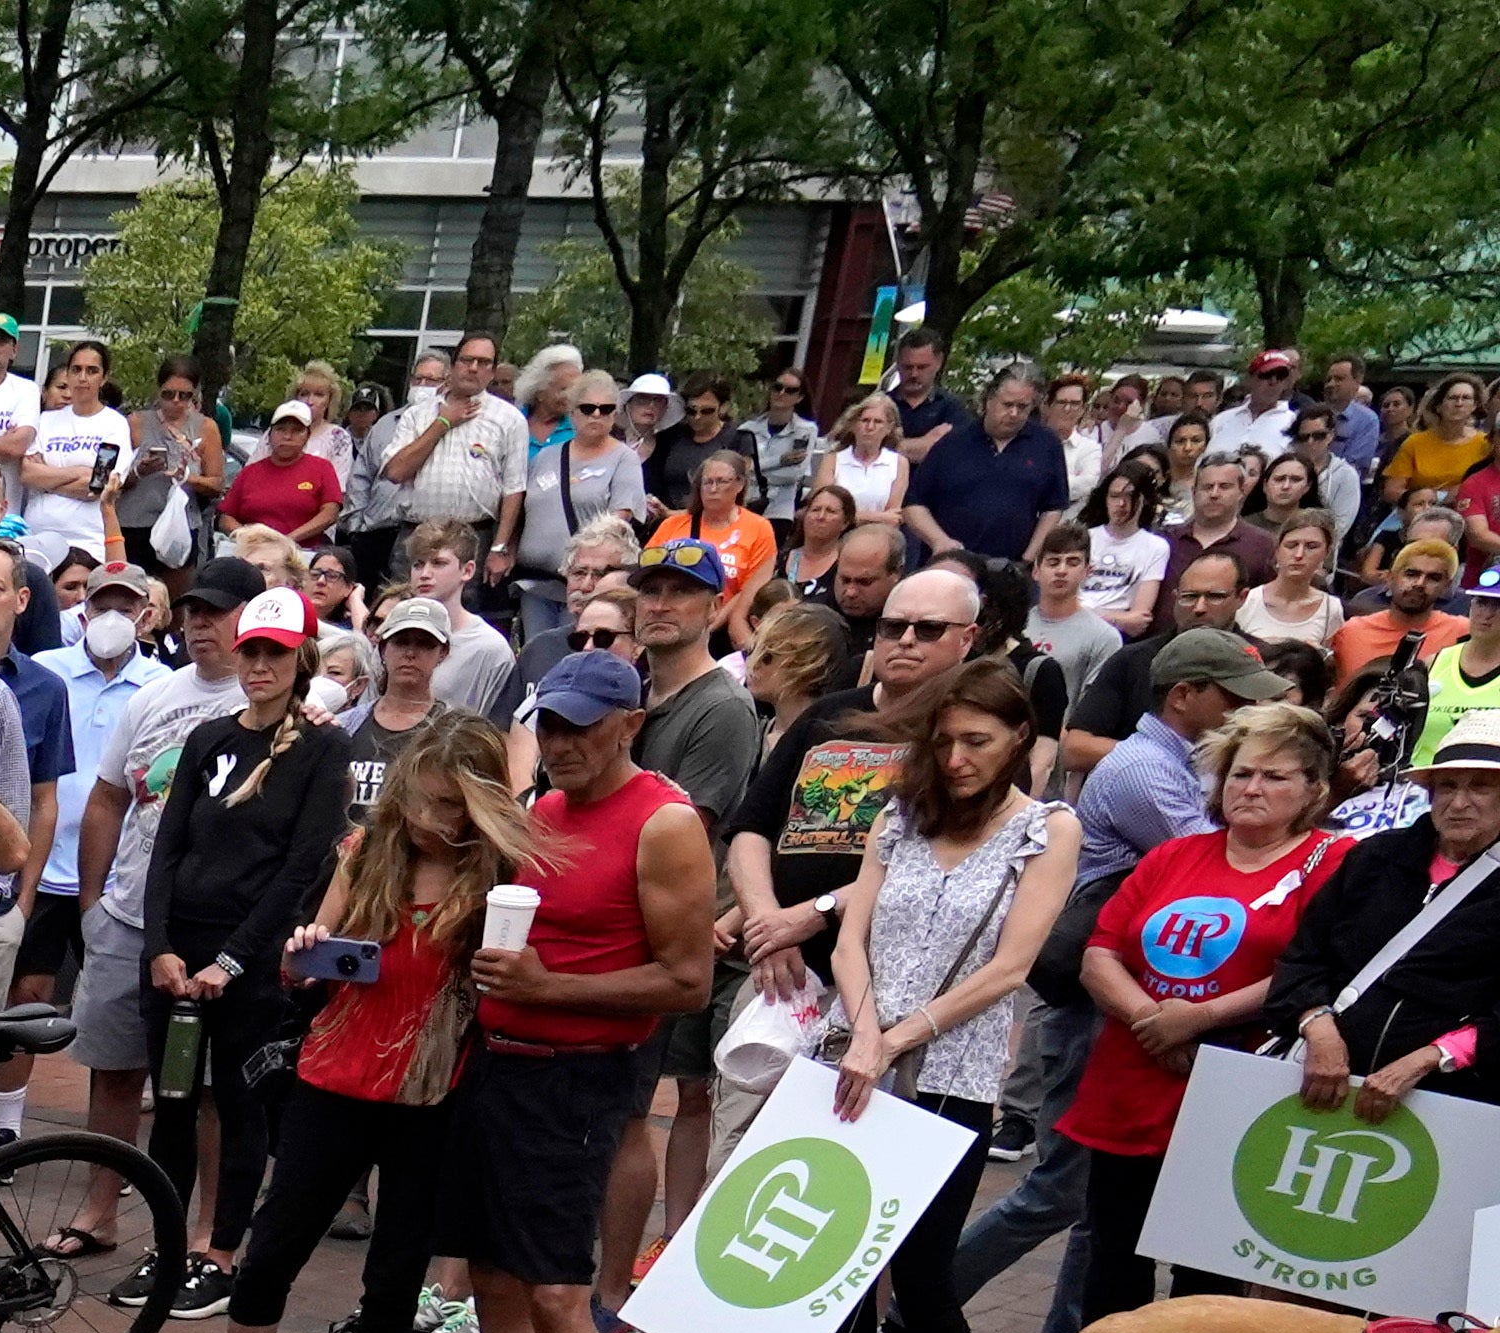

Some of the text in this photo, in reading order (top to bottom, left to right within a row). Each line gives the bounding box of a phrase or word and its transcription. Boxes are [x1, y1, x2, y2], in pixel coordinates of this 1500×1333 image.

[1154, 912, 1231, 957] HP
[1142, 969, 1221, 998] STRONG
[1265, 1125, 1412, 1223] HP
[719, 1159, 835, 1283] HP
[807, 1196, 902, 1318] STRONG
[1232, 1237, 1378, 1290] STRONG
